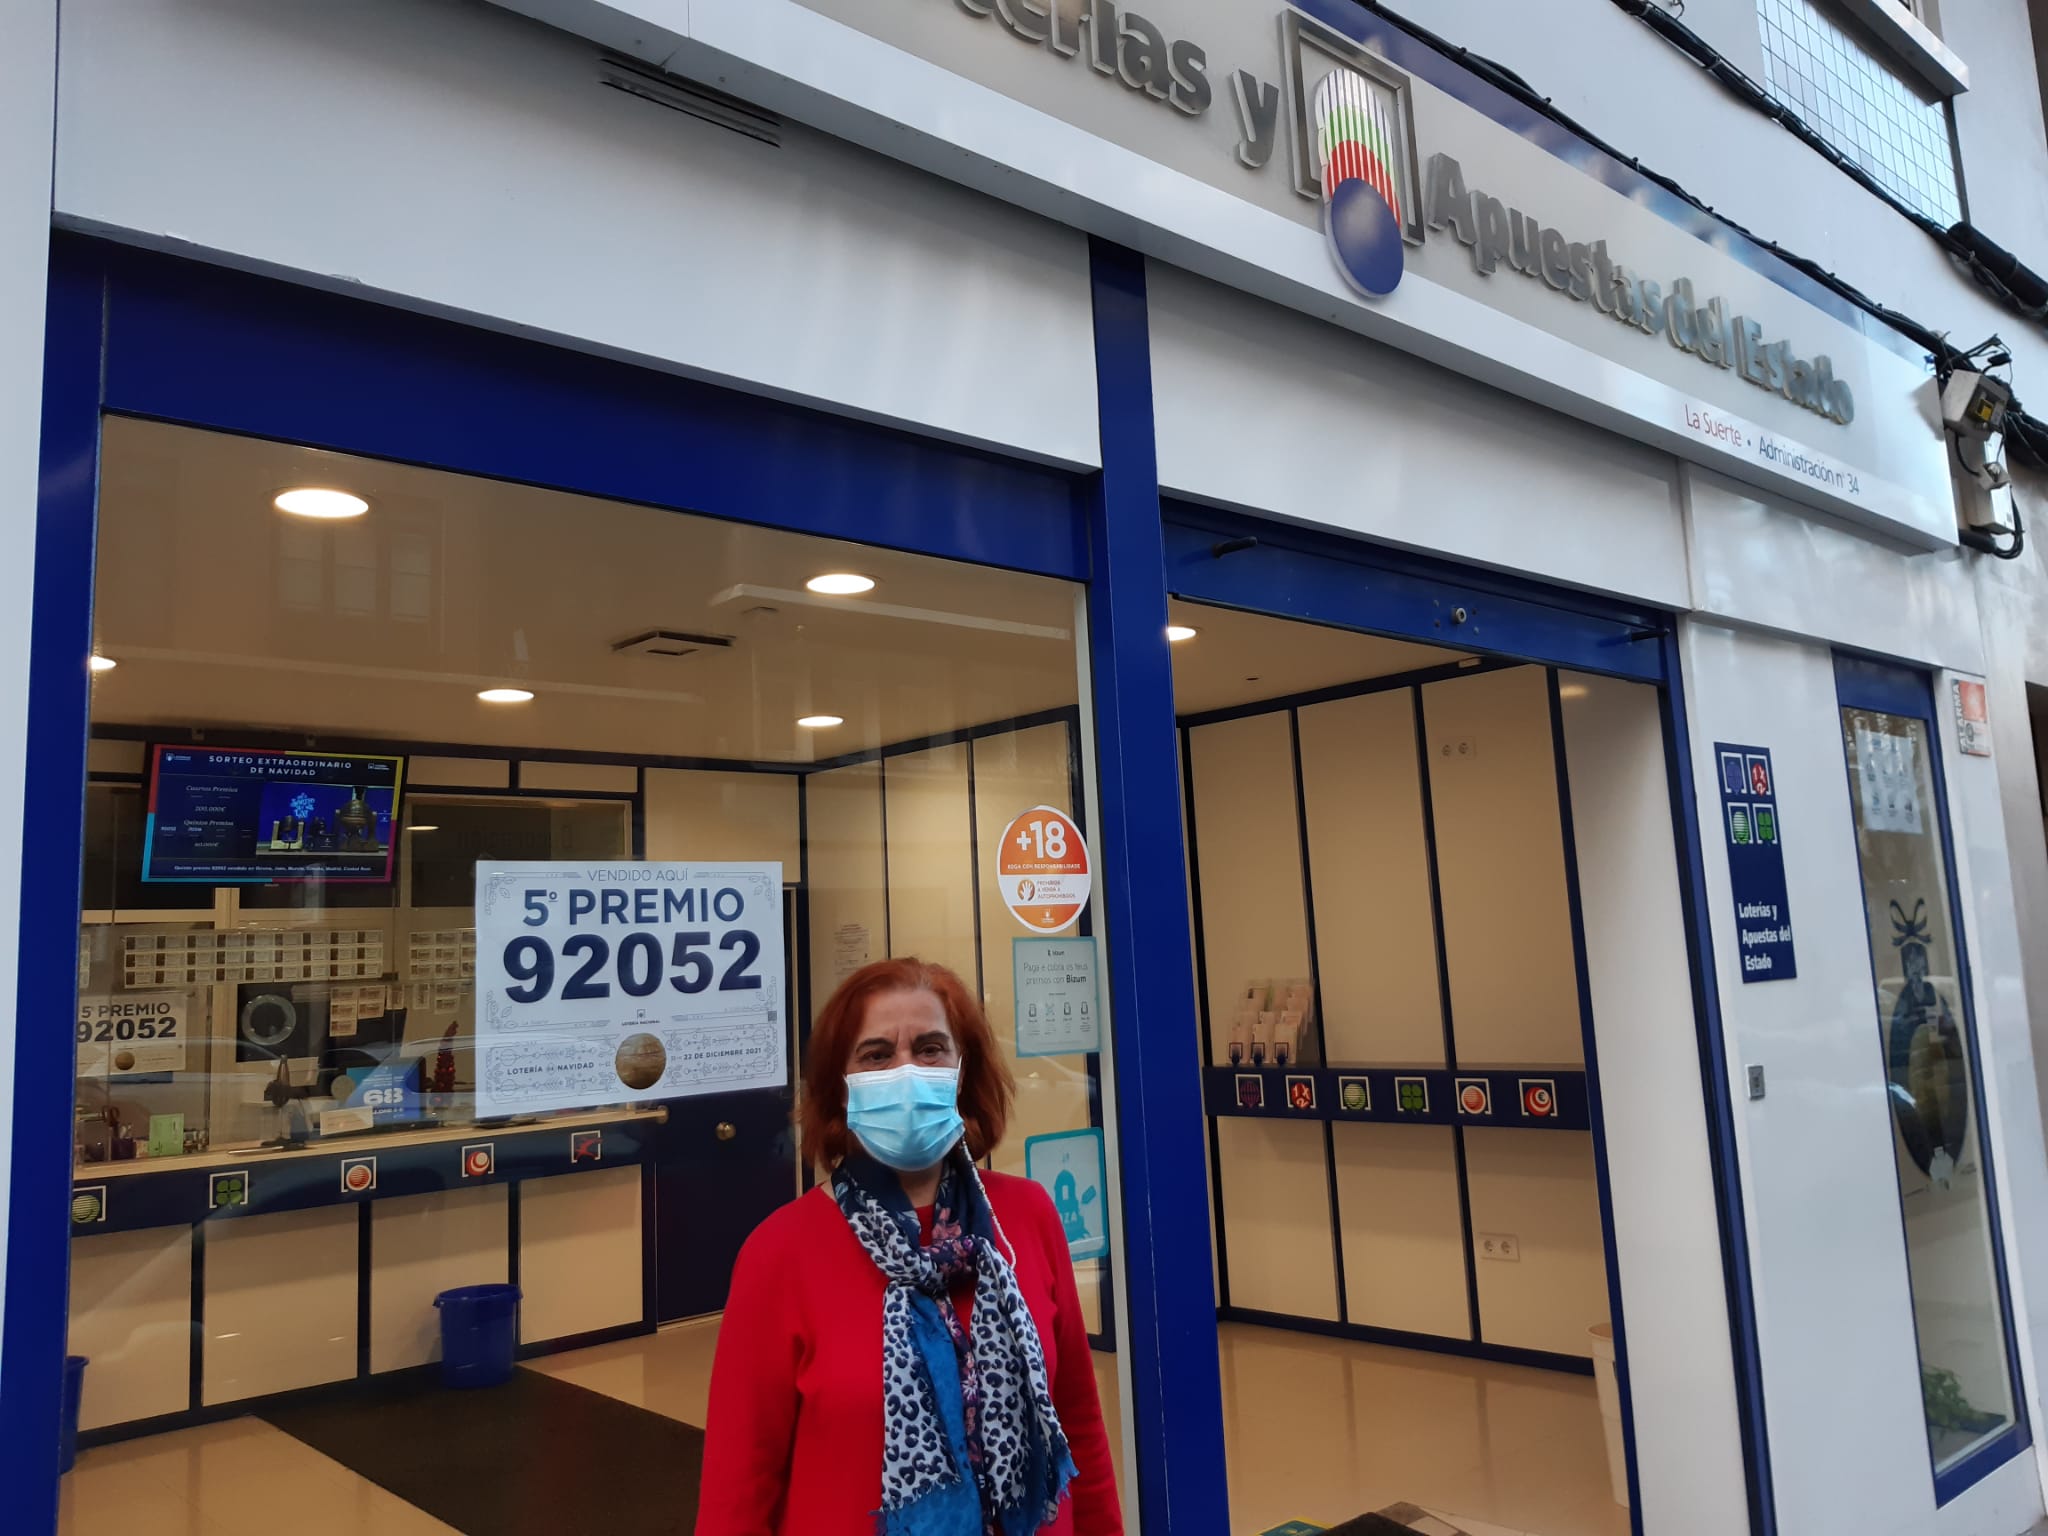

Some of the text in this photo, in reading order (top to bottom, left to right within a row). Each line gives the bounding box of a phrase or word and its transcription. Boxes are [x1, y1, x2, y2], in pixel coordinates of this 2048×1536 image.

[1230, 67, 1280, 168] y
[1425, 152, 1855, 425] Apuestas del Estado
[1685, 404, 1700, 430] La
[1702, 412, 1743, 447] Suerte
[1759, 436, 1834, 484] Administración
[1848, 473, 1860, 495] 34
[208, 755, 352, 769] SORTEO EXTRAORDINARIO
[268, 768, 316, 776] NAVIDAD
[1016, 820, 1067, 859] +18
[587, 867, 689, 882] VENDIDO AQUÍ
[569, 887, 745, 926] PREMIO
[1738, 901, 1778, 921] Loterías y
[1742, 925, 1792, 948] Apuestas del
[503, 929, 762, 1004] 92052
[1745, 955, 1773, 971] Estado
[1066, 974, 1087, 983] Bizum
[98, 1002, 171, 1018] PREMIO
[76, 1017, 177, 1043] 92052
[683, 1047, 762, 1061] 22 DE DICIEMBRE 2021
[507, 1065, 543, 1076] LOTERÍA
[557, 1061, 595, 1072] NAVIDAD
[363, 1087, 404, 1107] 68
